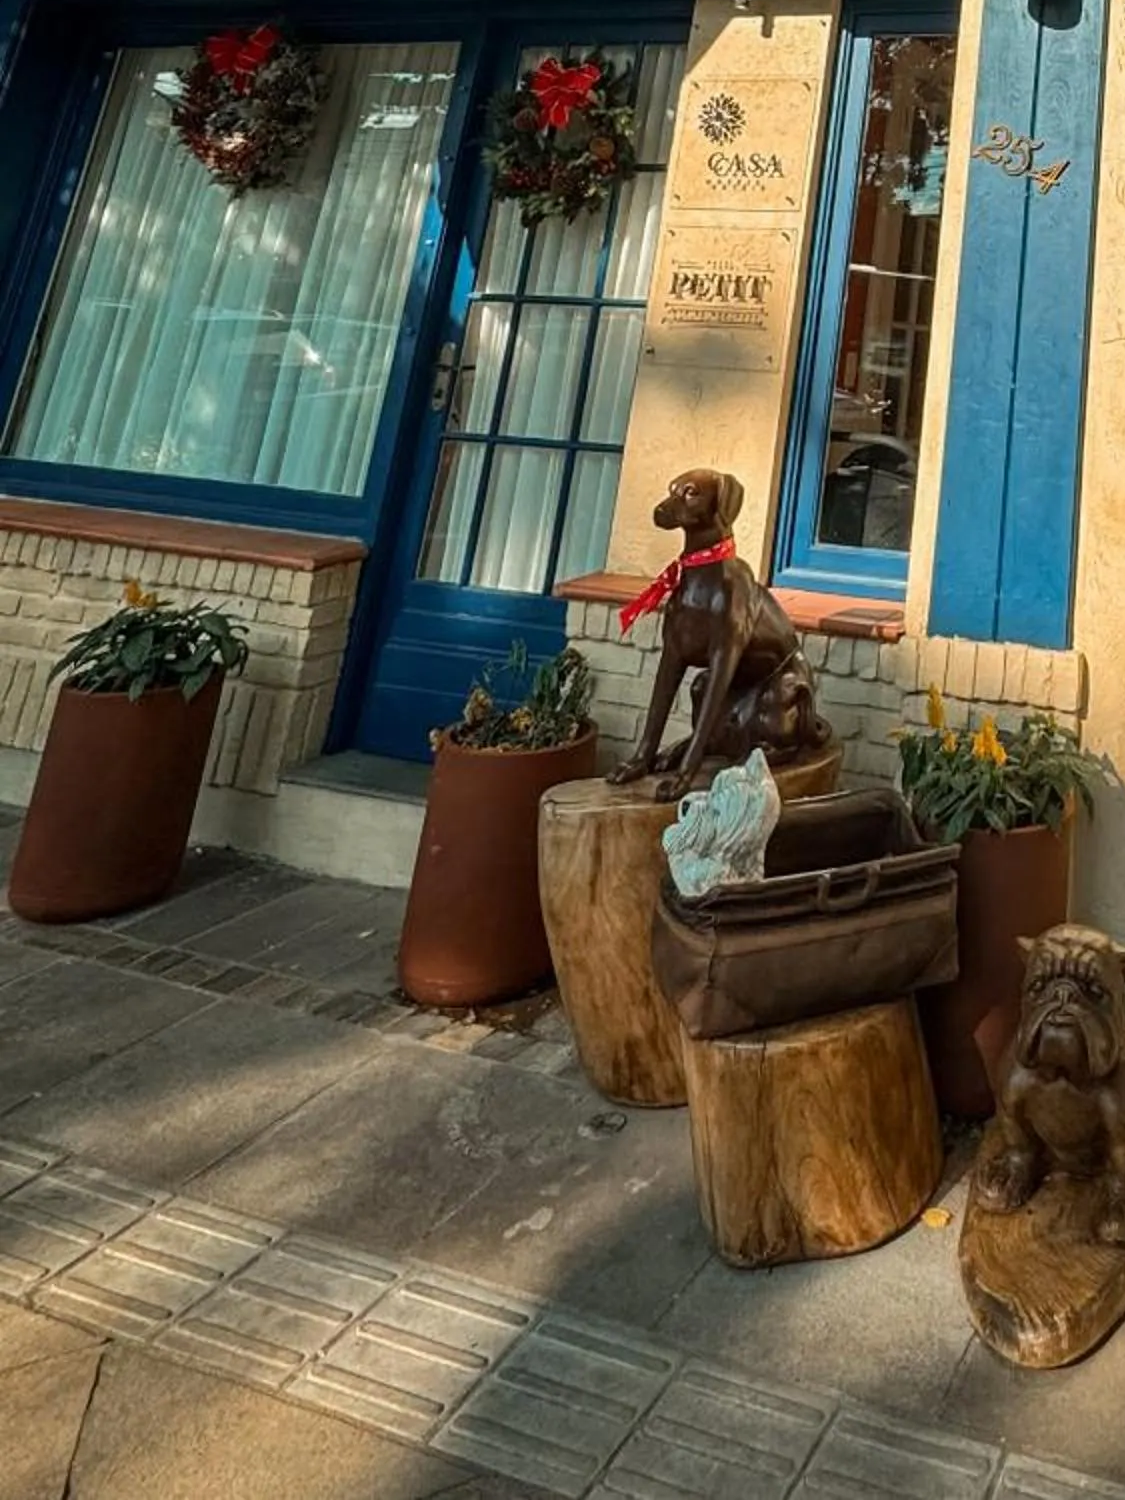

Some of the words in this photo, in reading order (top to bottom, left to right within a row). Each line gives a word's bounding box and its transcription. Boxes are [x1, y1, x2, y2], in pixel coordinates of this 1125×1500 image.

[707, 151, 785, 179] CASA
[972, 124, 1071, 195] 254
[668, 271, 772, 303] PETIT
